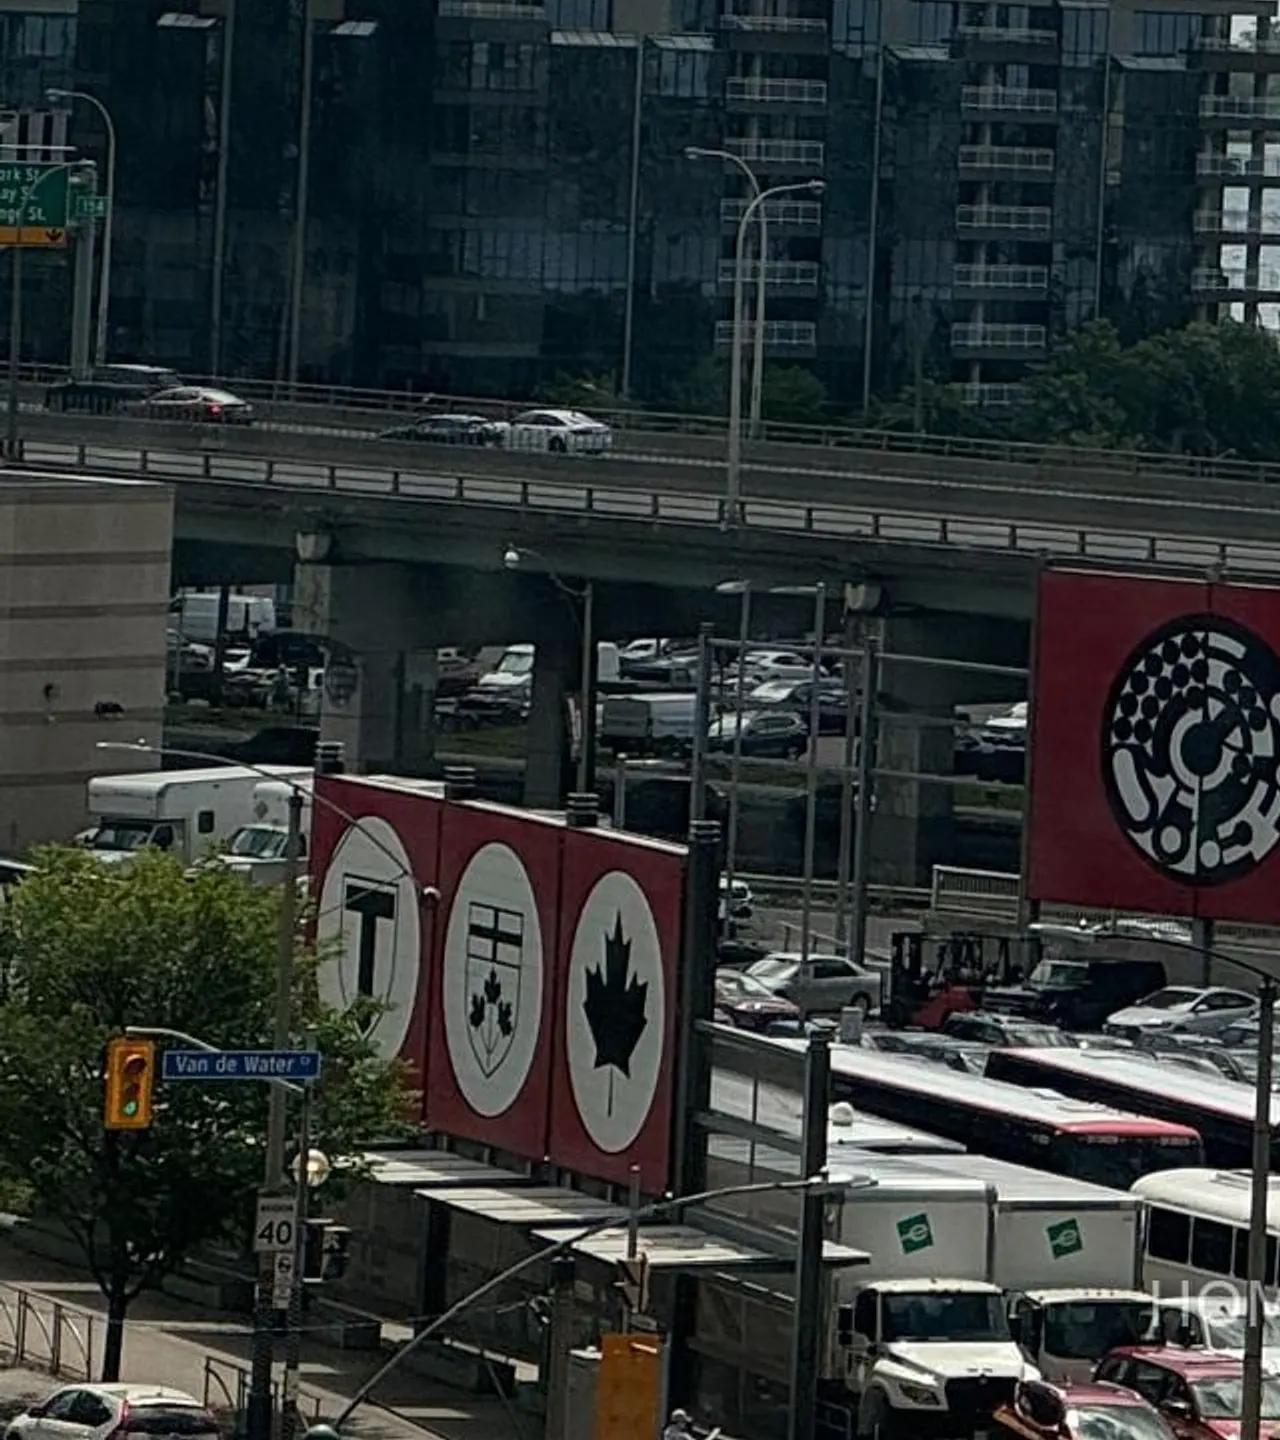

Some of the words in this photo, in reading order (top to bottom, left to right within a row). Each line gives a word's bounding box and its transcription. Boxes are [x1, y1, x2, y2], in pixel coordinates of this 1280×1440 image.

[176, 1056, 209, 1073] Van
[216, 1056, 237, 1073] de
[244, 1056, 295, 1073] Water
[259, 1221, 292, 1244] 40
